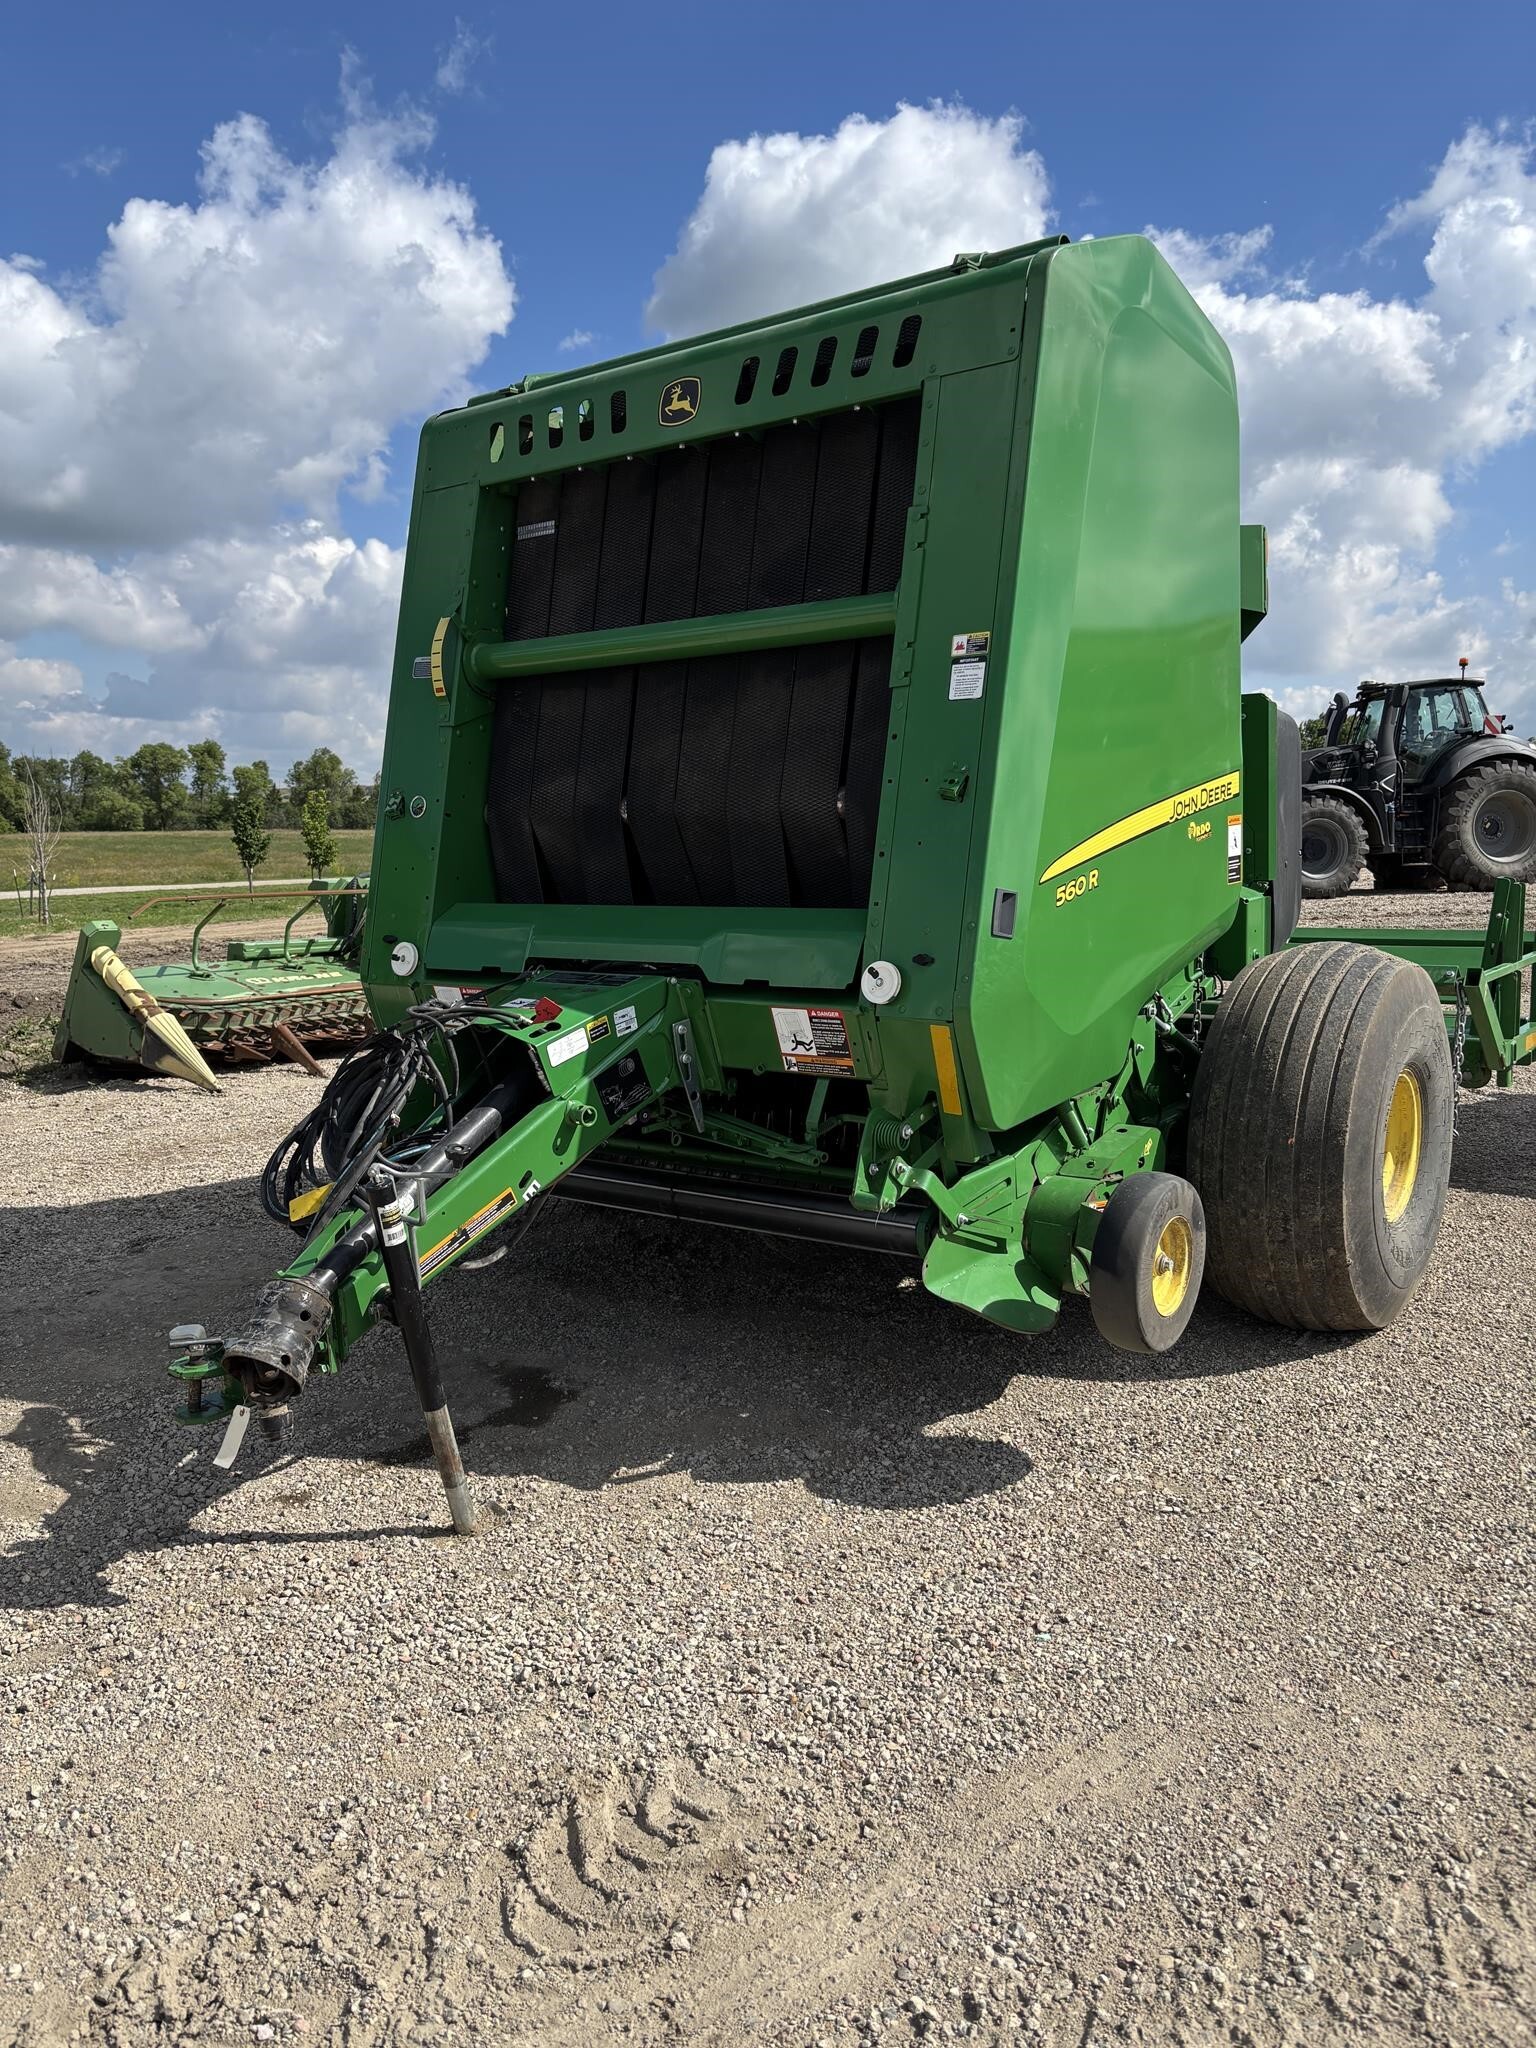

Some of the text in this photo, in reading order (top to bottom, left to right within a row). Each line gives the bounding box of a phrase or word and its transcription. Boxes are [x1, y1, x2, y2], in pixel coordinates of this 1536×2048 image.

[1169, 781, 1232, 820] JOHN DEERE
[1055, 868, 1099, 907] 560 R
